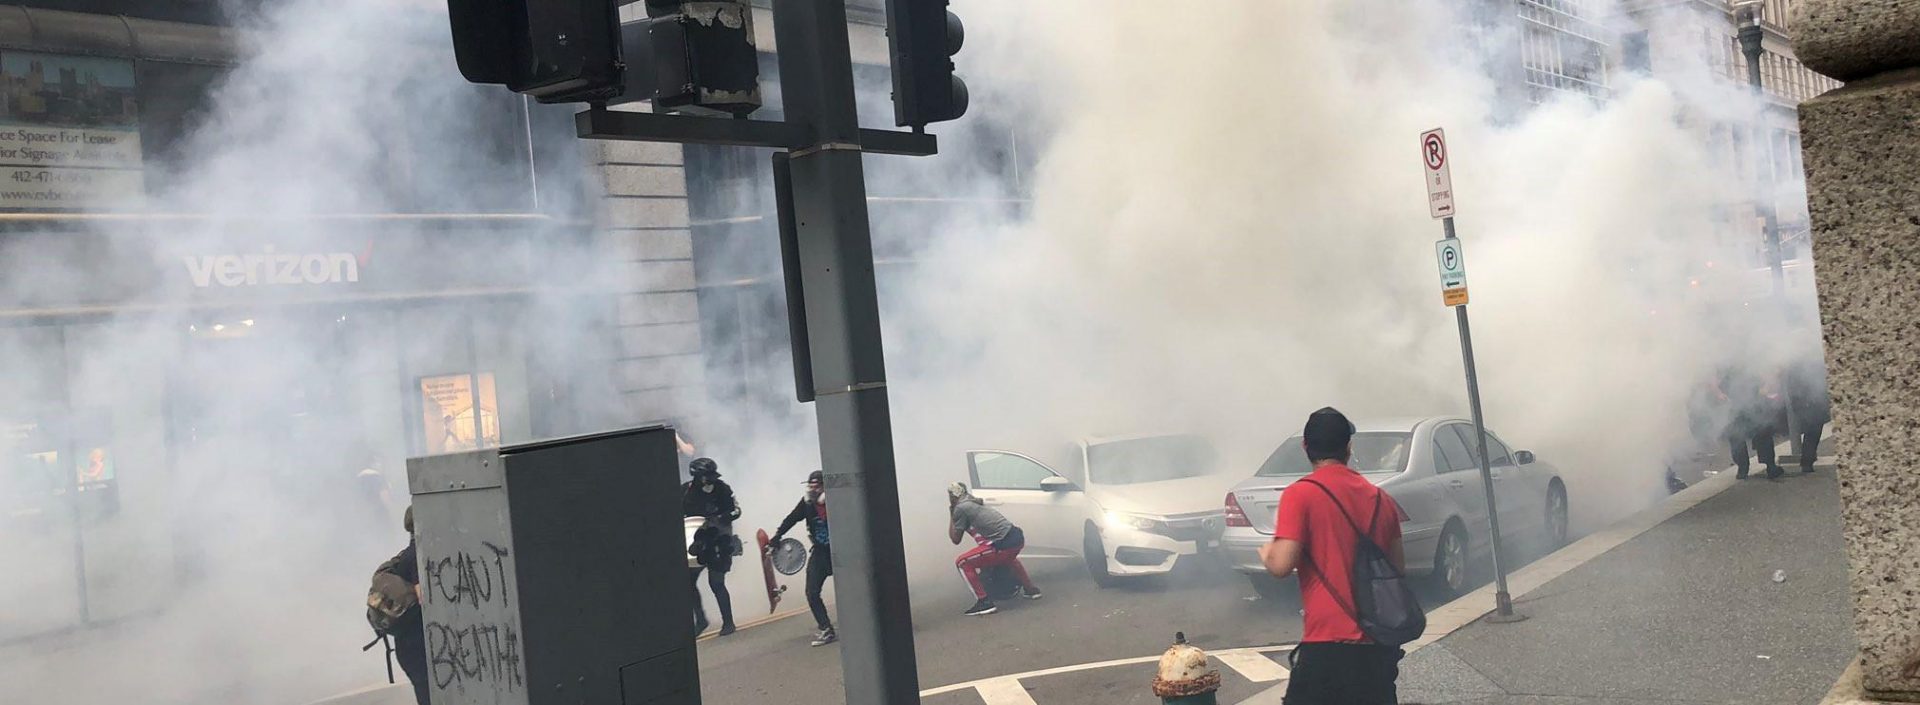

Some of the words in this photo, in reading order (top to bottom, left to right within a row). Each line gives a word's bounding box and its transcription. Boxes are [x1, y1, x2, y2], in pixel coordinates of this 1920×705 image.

[18, 129, 57, 144] Space
[60, 131, 79, 143] For
[82, 132, 117, 145] Lease
[20, 146, 68, 162] Signage
[184, 243, 359, 288] verizon
[1446, 250, 1454, 267] P
